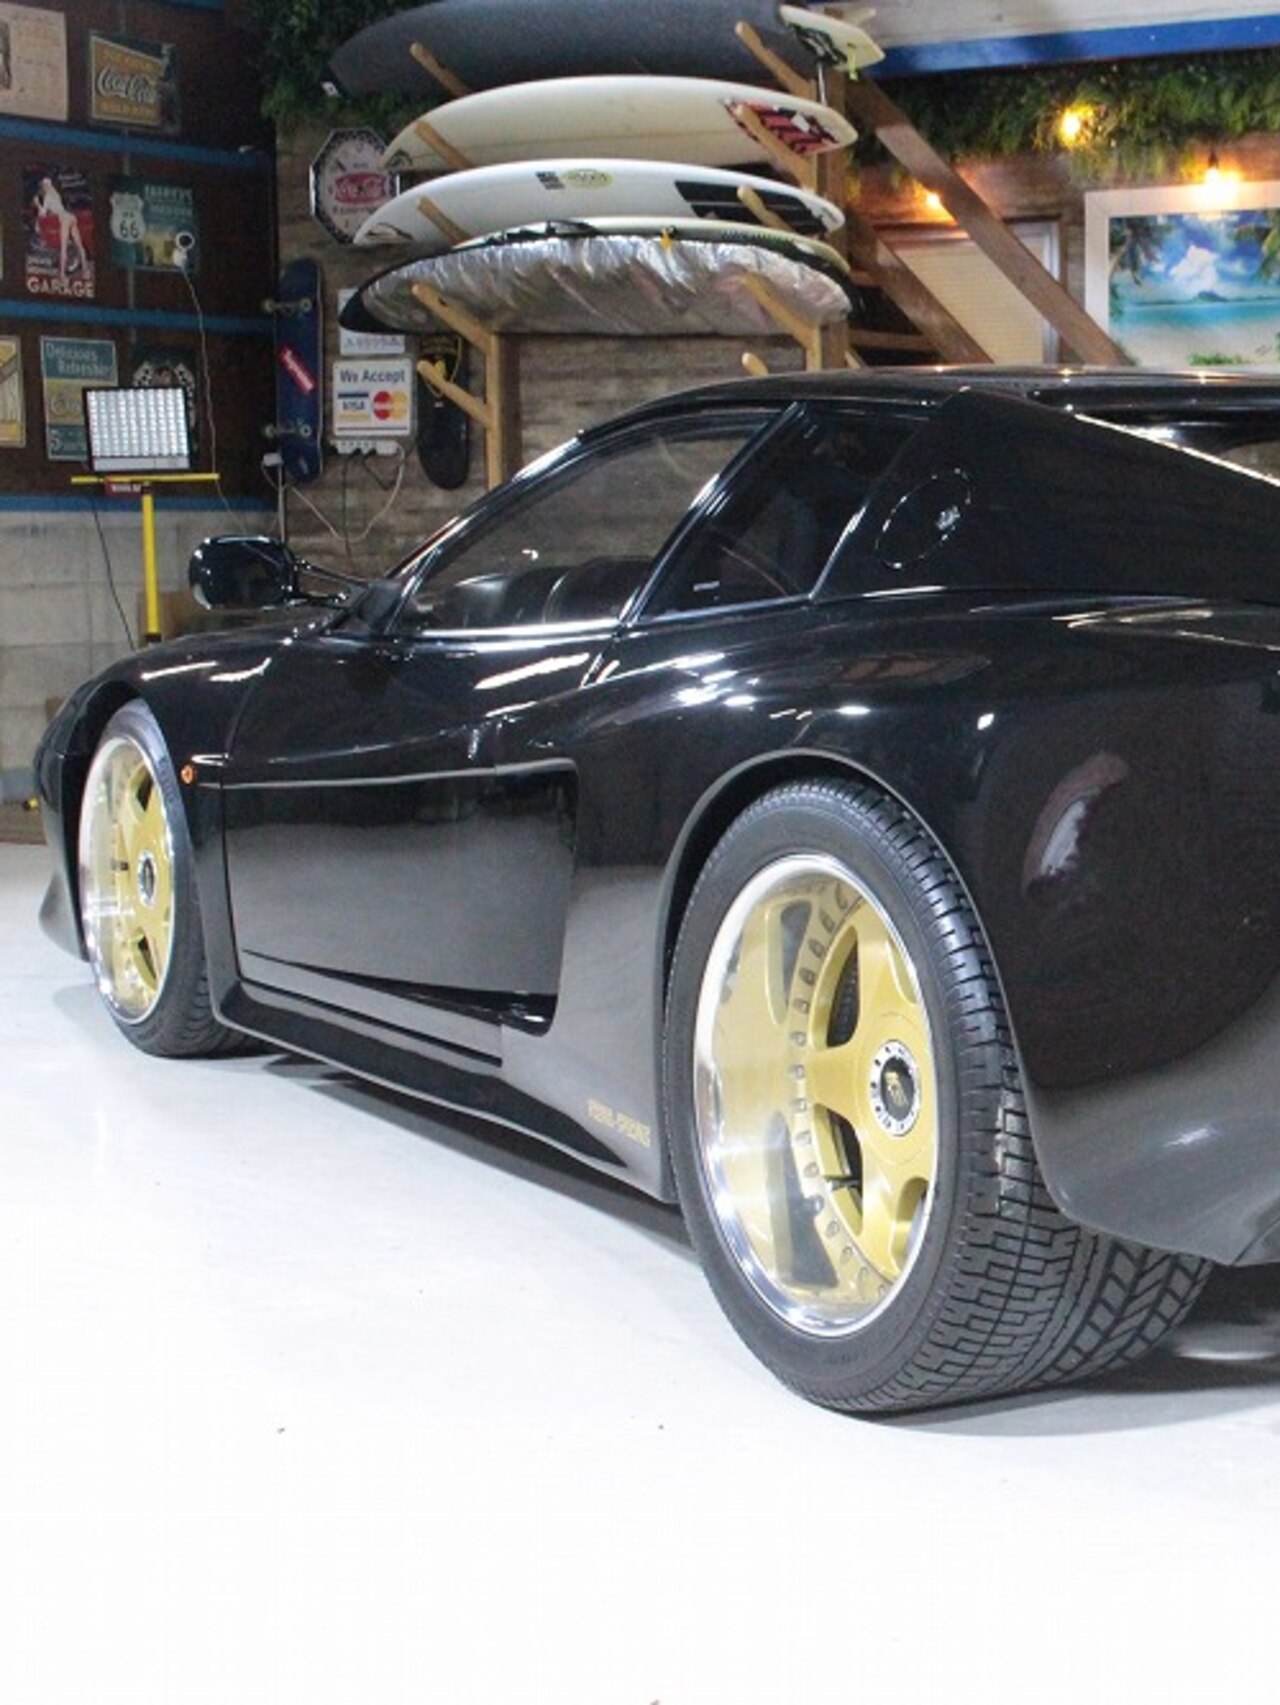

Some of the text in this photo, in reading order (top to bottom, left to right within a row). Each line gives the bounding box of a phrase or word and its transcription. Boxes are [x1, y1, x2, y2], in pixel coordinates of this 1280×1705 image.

[119, 218, 139, 239] 66
[26, 275, 96, 298] GARAGE
[340, 368, 405, 385] We Accept
